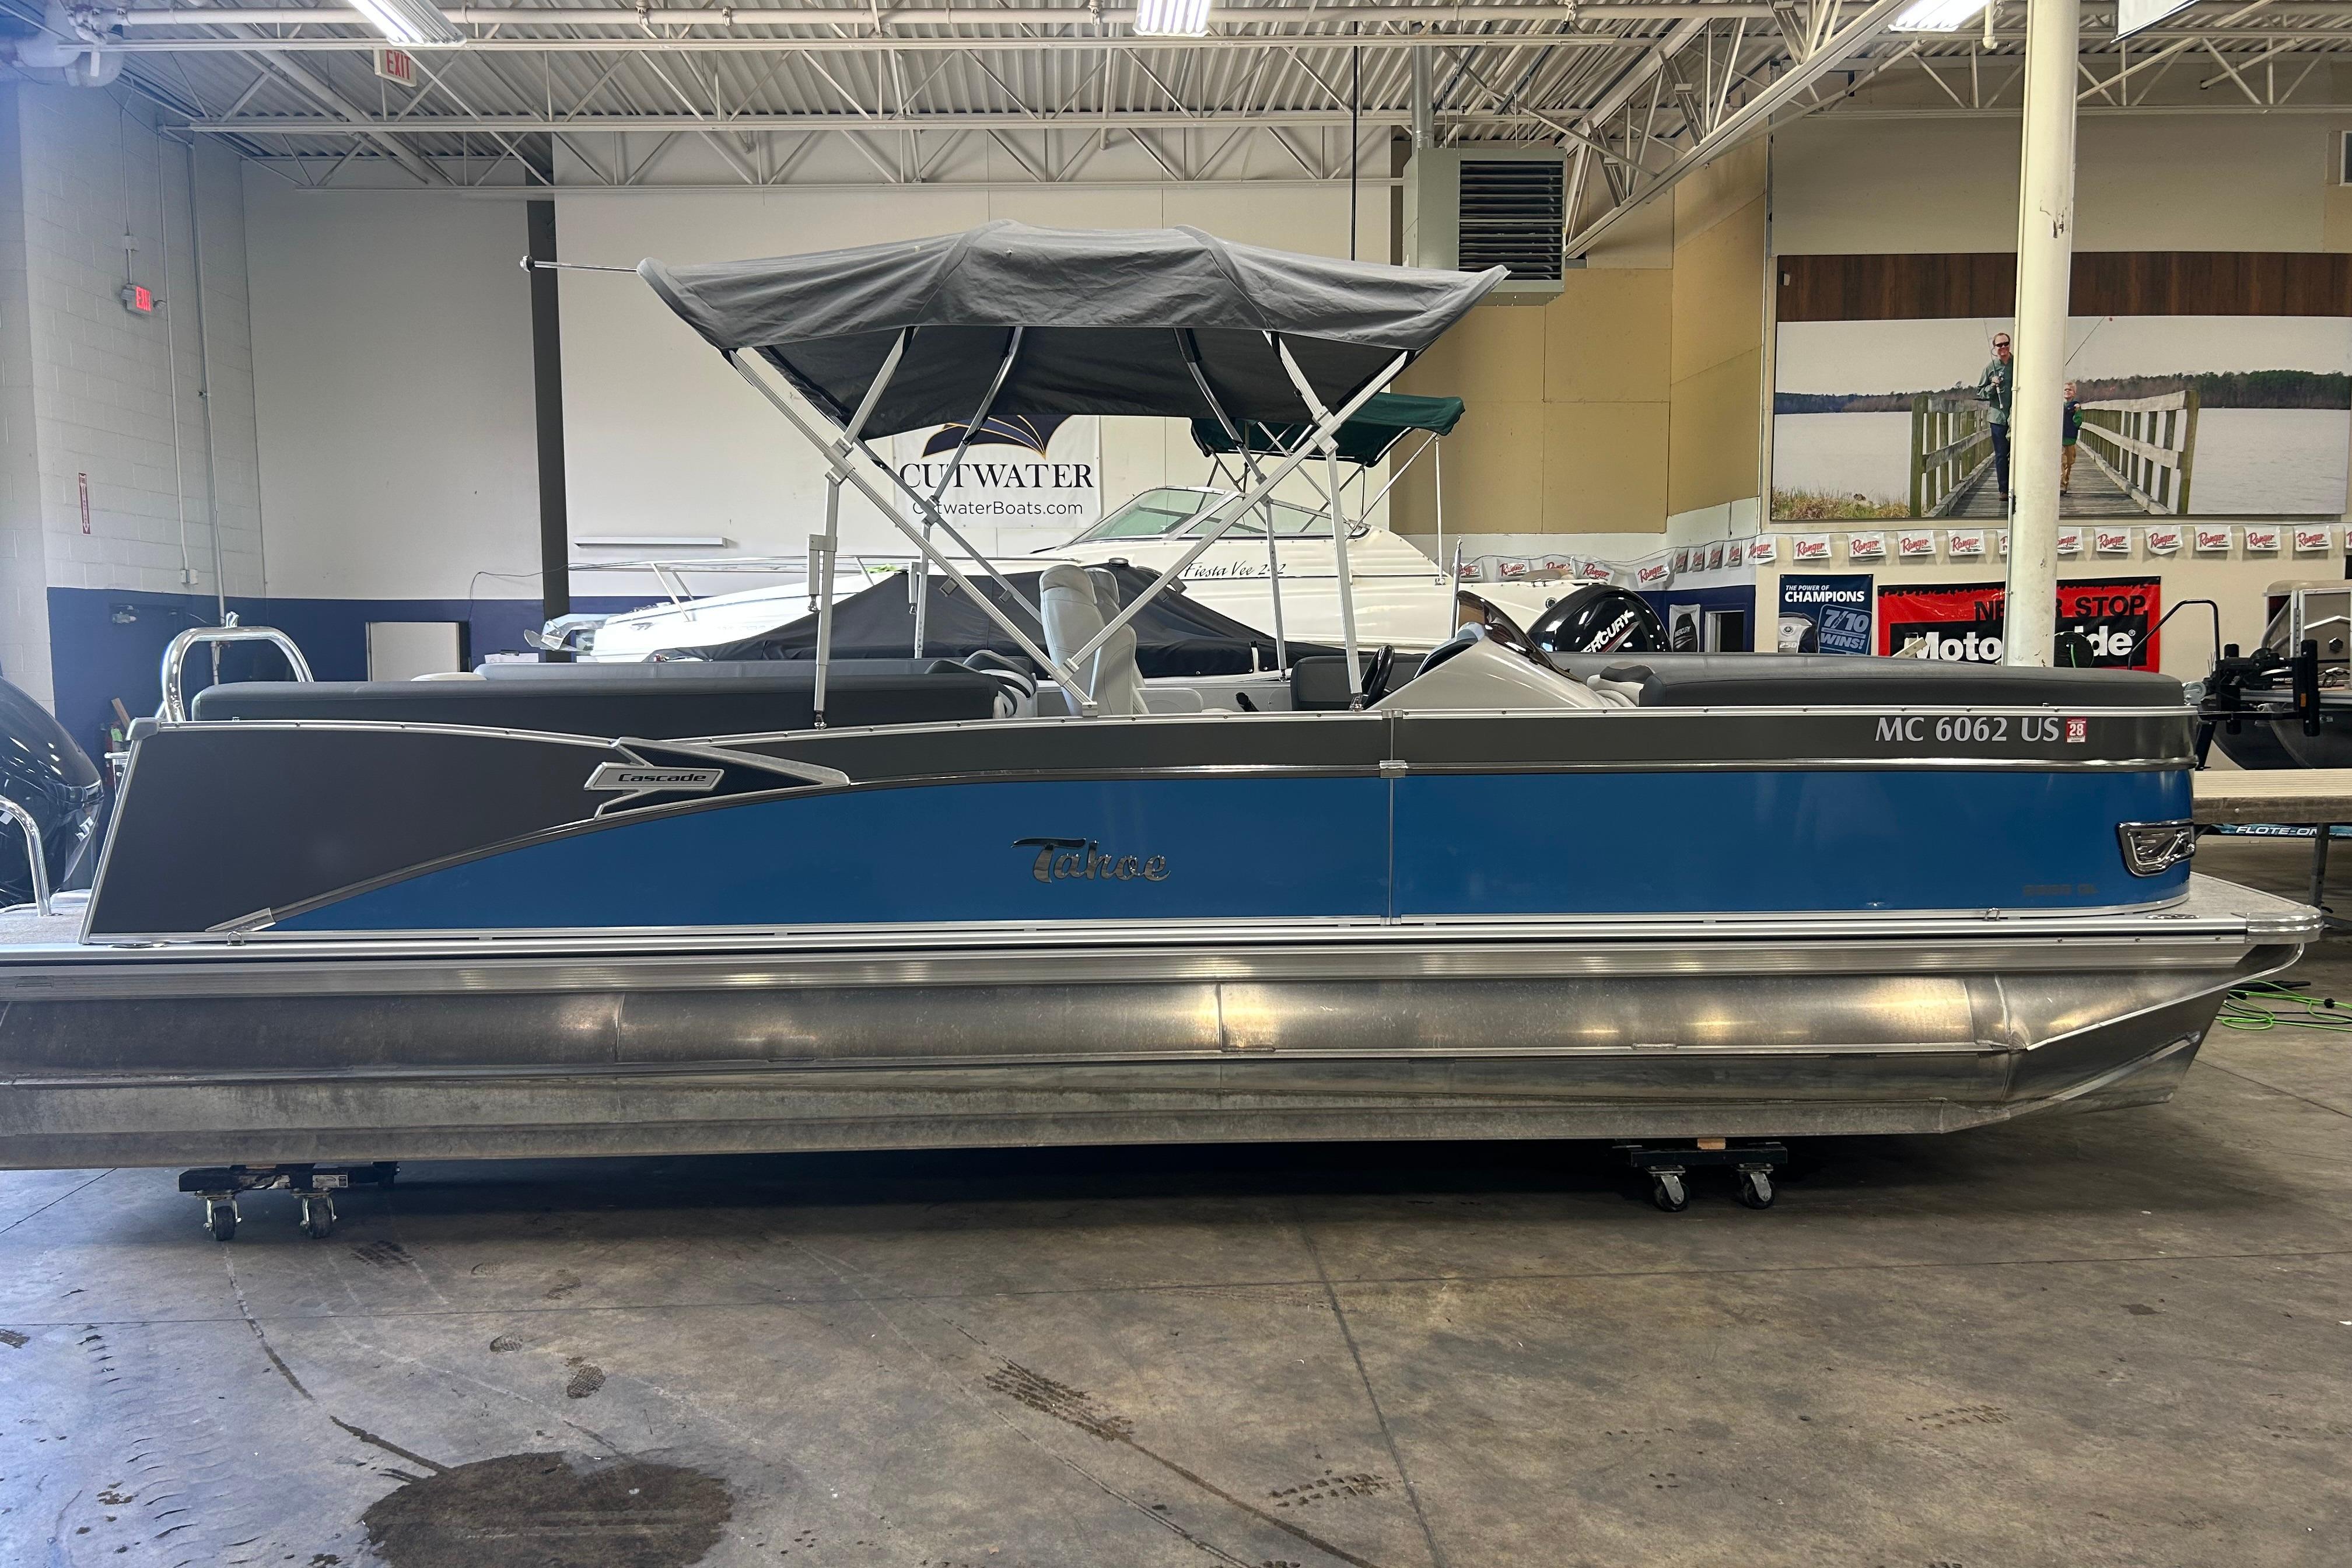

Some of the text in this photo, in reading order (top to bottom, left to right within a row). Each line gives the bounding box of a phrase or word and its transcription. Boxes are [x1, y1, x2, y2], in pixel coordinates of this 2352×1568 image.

[386, 50, 411, 80] EXIT
[900, 464, 1094, 488] CUTWATER
[912, 501, 1083, 514] CtwaterBoats.com
[1851, 539, 1880, 555] Ranger
[1900, 537, 1929, 554] Ranger
[1951, 536, 1979, 552] Ranger
[2057, 536, 2077, 547] anger
[2097, 533, 2126, 549] Ranger
[2148, 533, 2176, 548] Ranger
[2197, 532, 2226, 548] Ranger
[2247, 532, 2274, 547] Ranger
[2297, 532, 2325, 548] Ranger
[1796, 541, 1825, 557] Ranger
[1184, 561, 1286, 578] Fiesta Vee 22
[1583, 564, 1610, 578] Ranger
[1637, 565, 1662, 583] Ranger
[1784, 591, 1865, 603] CHAMPIONS
[2074, 595, 2146, 617] STOP
[1824, 609, 1870, 633] 7/10
[1580, 610, 1634, 652] ERCURY
[1820, 632, 1865, 650] WINS!
[1875, 717, 2060, 741] MC 6062 US
[2069, 723, 2084, 736] 28
[618, 774, 707, 782] Cascade
[1012, 836, 1171, 883] Tahoe
